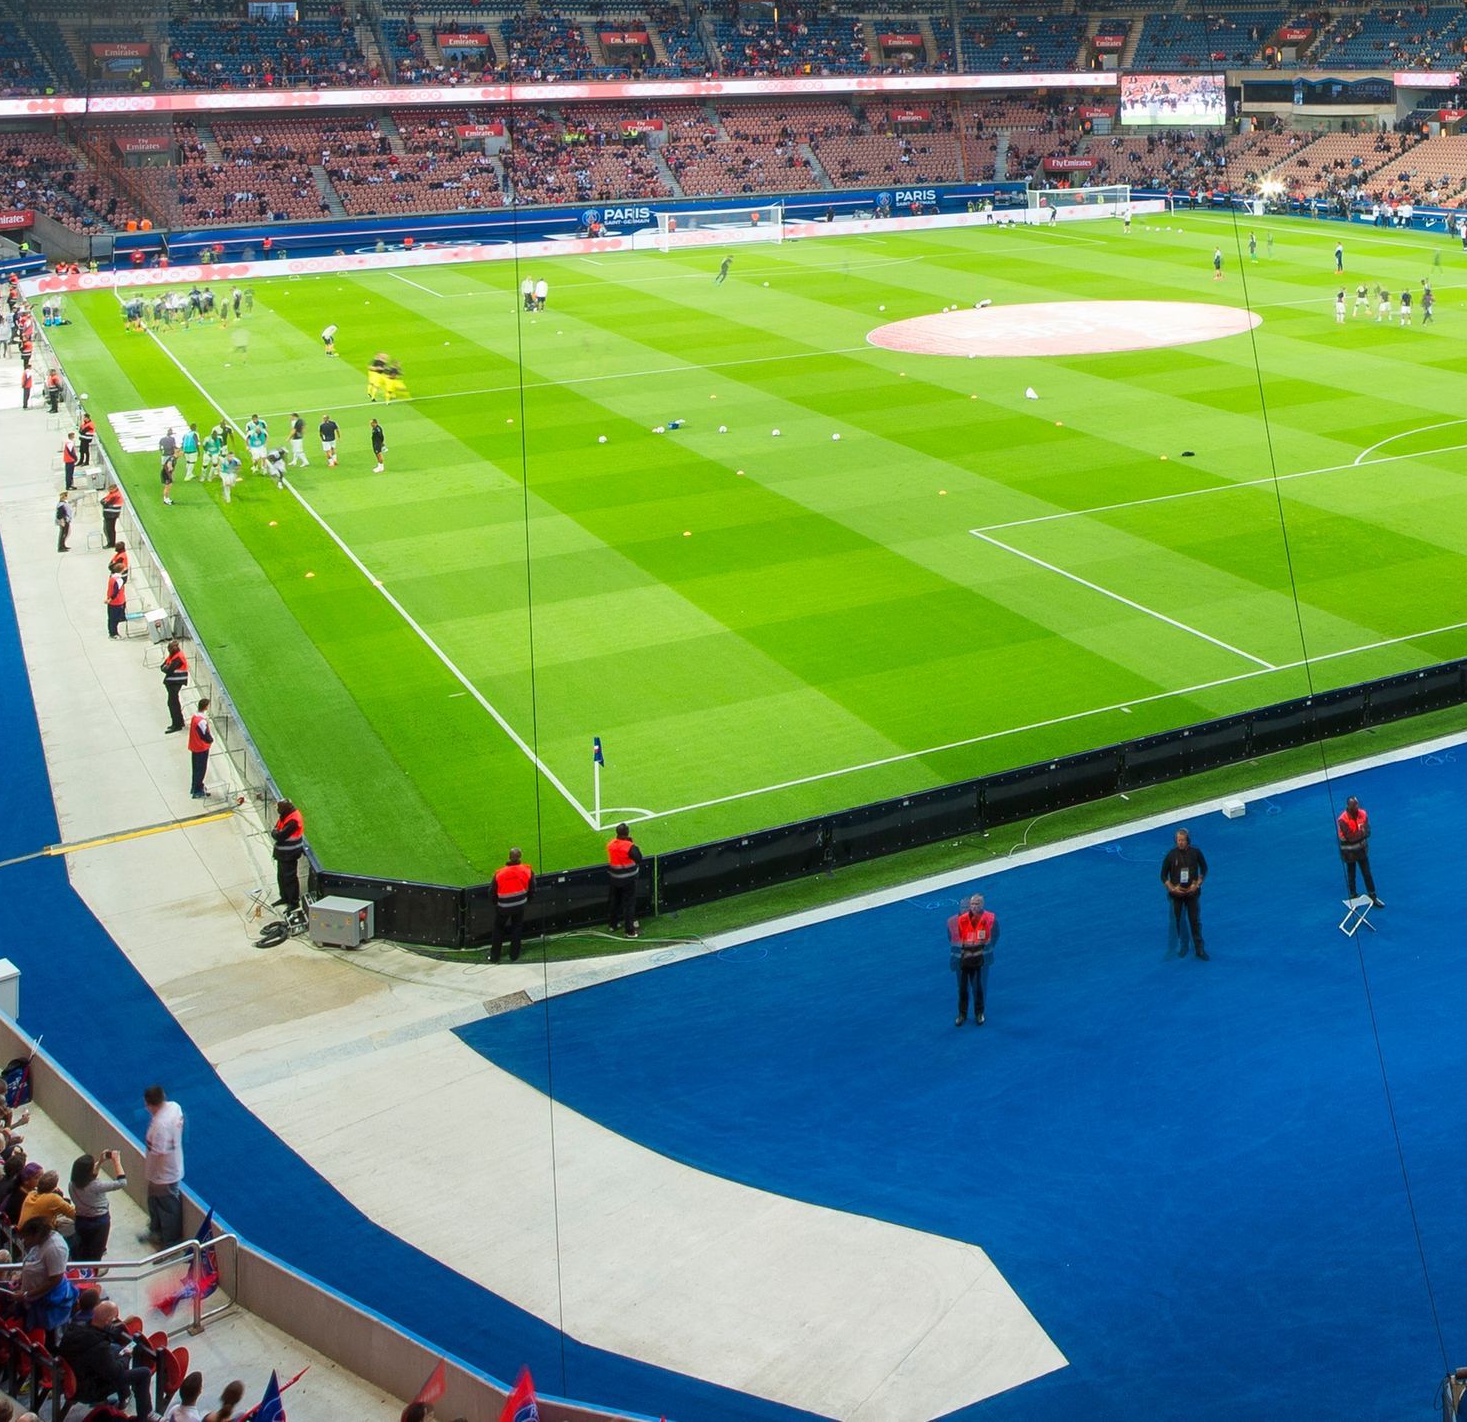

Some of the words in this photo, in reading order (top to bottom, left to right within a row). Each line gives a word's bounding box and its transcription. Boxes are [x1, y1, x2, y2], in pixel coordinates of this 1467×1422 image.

[126, 143, 160, 151] Emirates
[1052, 159, 1063, 168] Fly
[1064, 158, 1092, 166] Emirates
[895, 190, 937, 202] PARIS
[604, 207, 650, 220] PARIS
